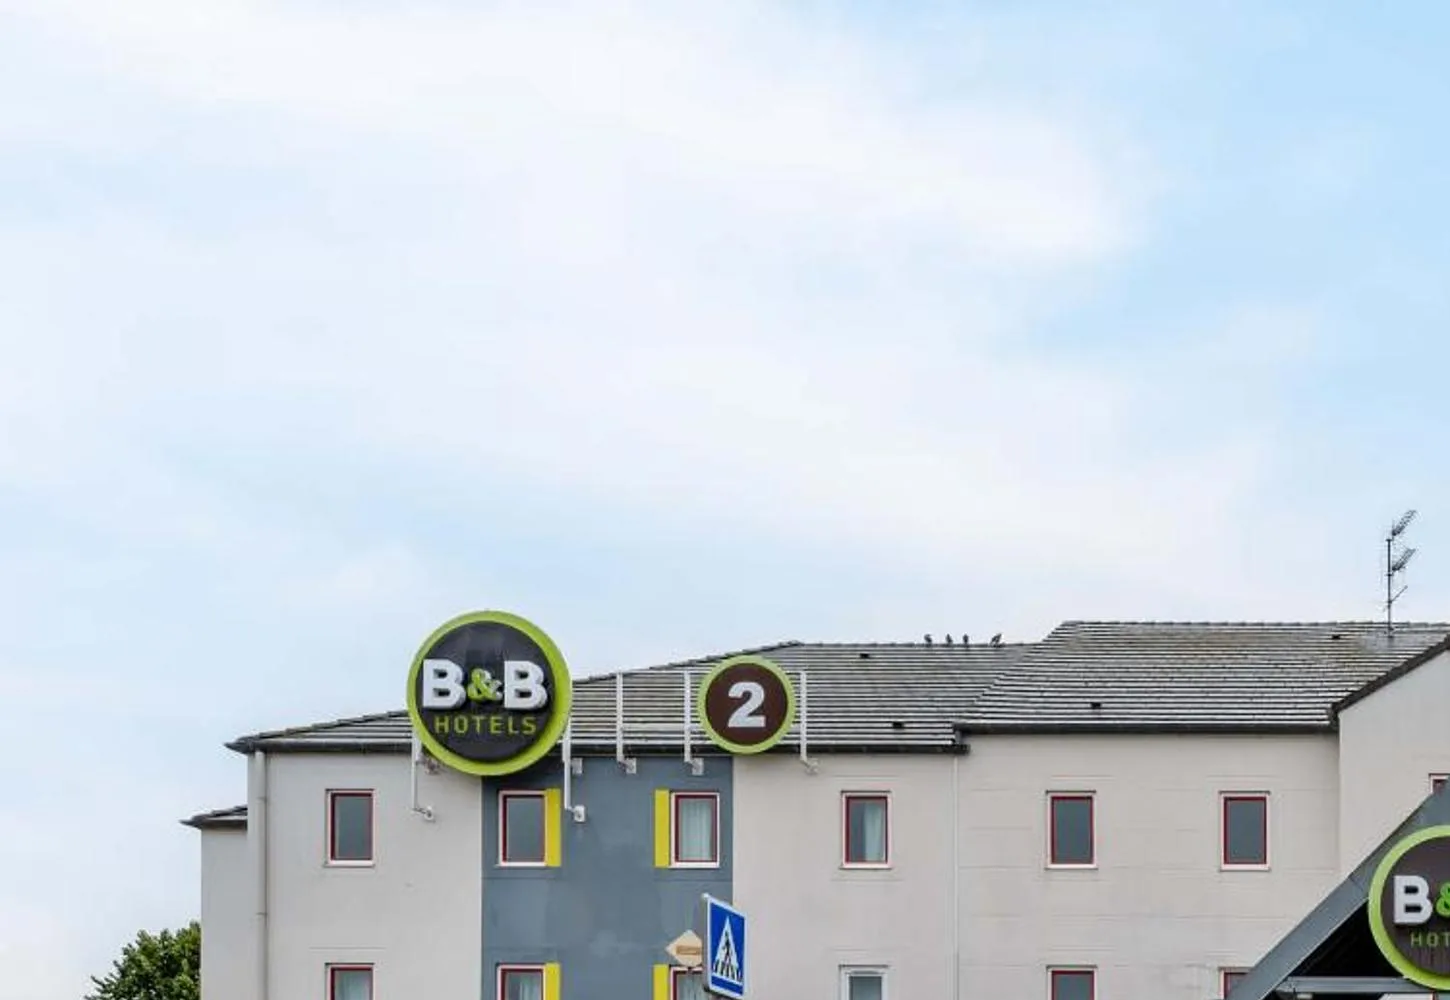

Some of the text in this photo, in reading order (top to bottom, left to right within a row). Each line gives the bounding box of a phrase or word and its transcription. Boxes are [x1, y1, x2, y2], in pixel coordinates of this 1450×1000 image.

[422, 659, 549, 710] B&B
[727, 681, 767, 729] 2
[434, 714, 538, 736] HOTELS
